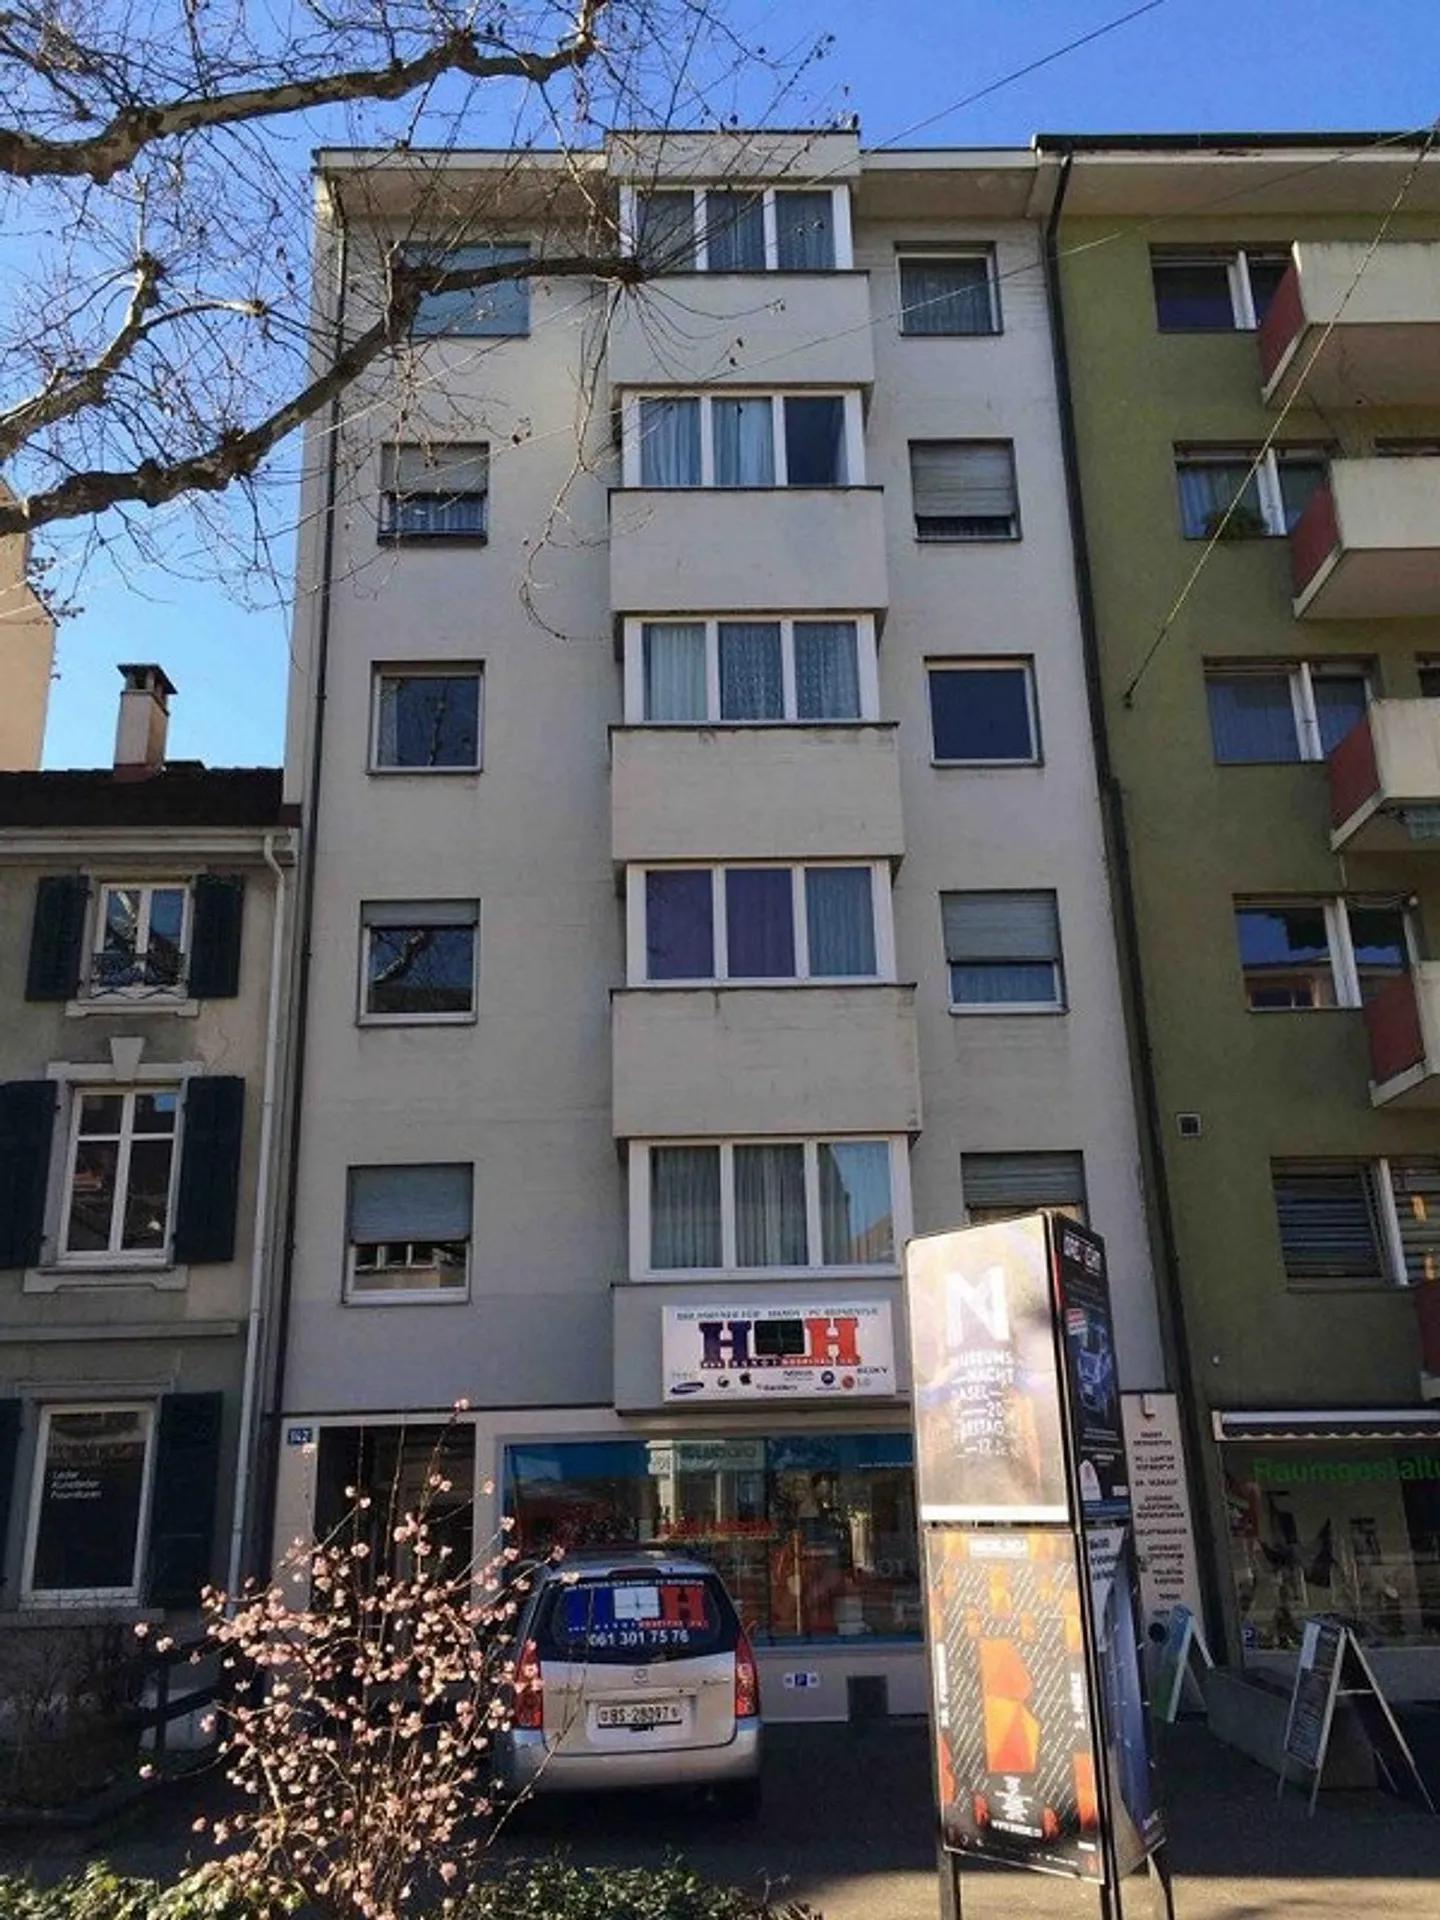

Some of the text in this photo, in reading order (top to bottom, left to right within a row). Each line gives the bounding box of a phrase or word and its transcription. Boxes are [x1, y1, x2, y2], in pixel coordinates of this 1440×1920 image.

[699, 1318, 860, 1369] H H
[652, 1630, 668, 1644] 75
